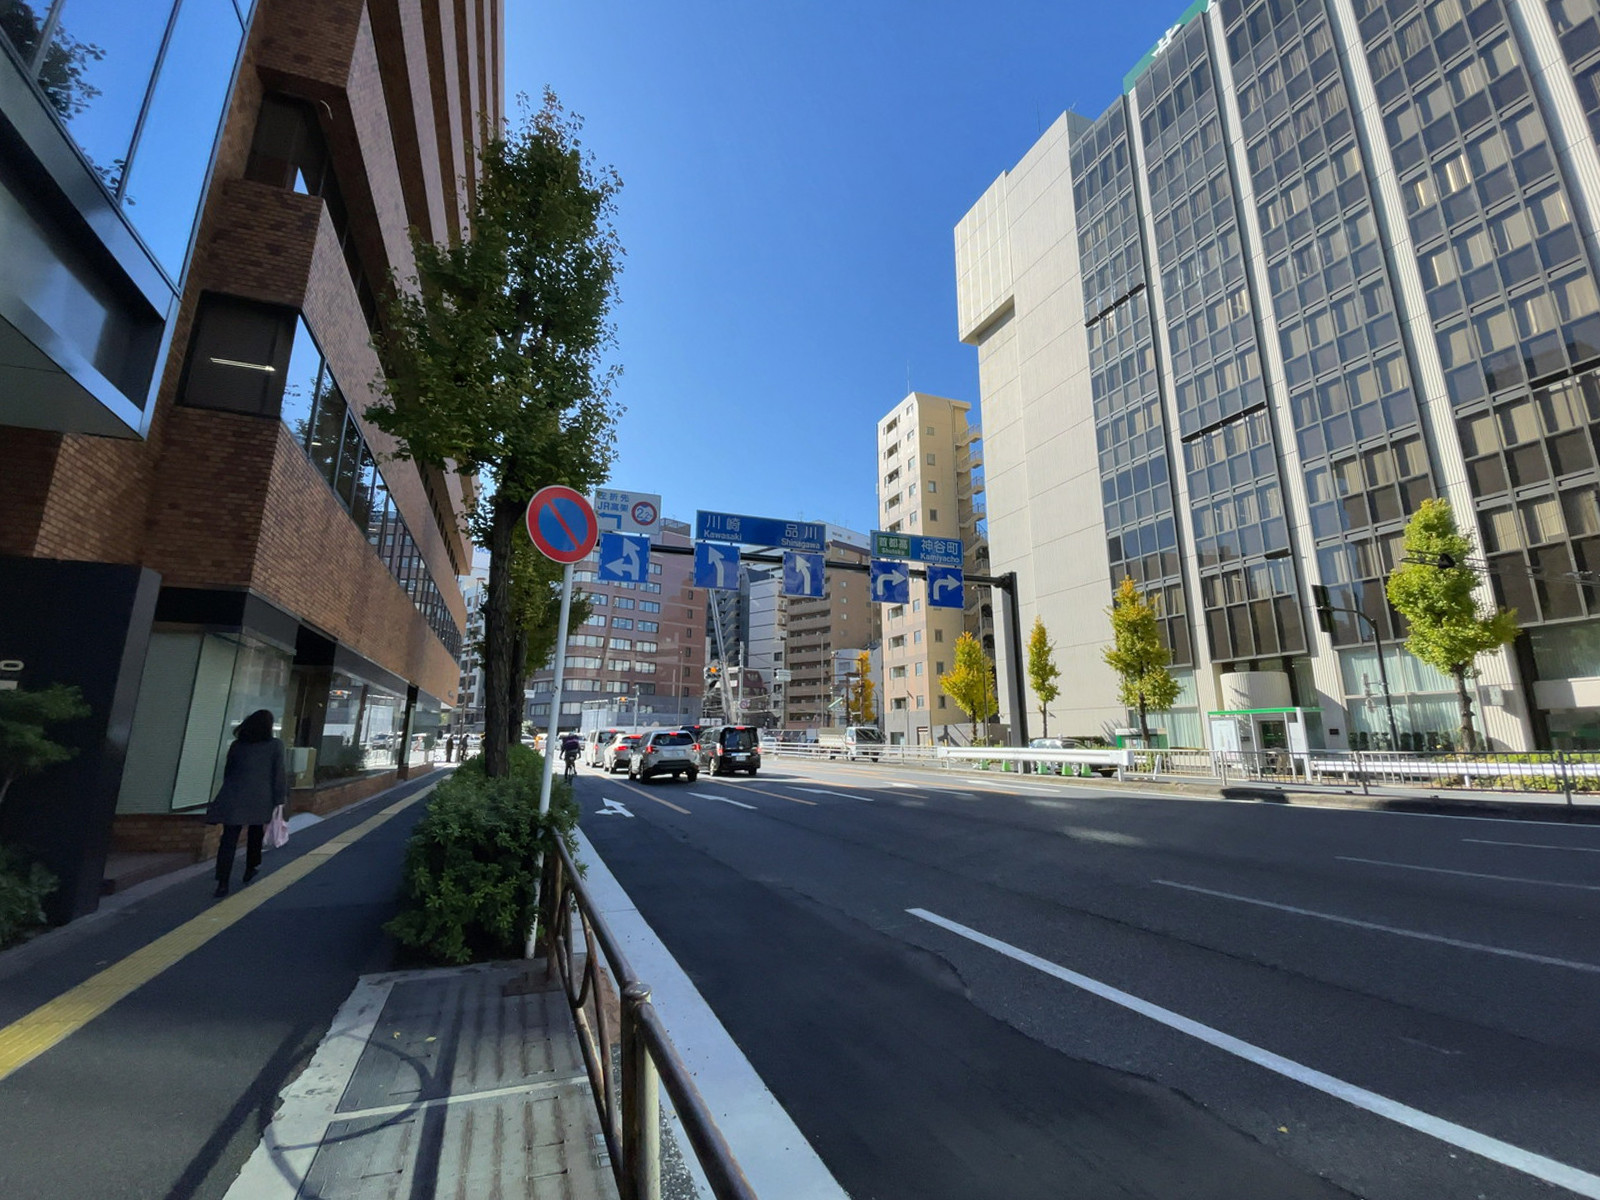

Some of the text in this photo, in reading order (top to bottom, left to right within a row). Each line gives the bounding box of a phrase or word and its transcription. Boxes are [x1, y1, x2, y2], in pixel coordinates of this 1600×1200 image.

[706, 515, 741, 531] 川崎
[703, 529, 742, 541] Kawasaki
[785, 523, 818, 540] 品川
[781, 537, 821, 550] Shinagawa
[921, 539, 958, 555] 神谷町
[920, 552, 960, 563] Kamiyacho
